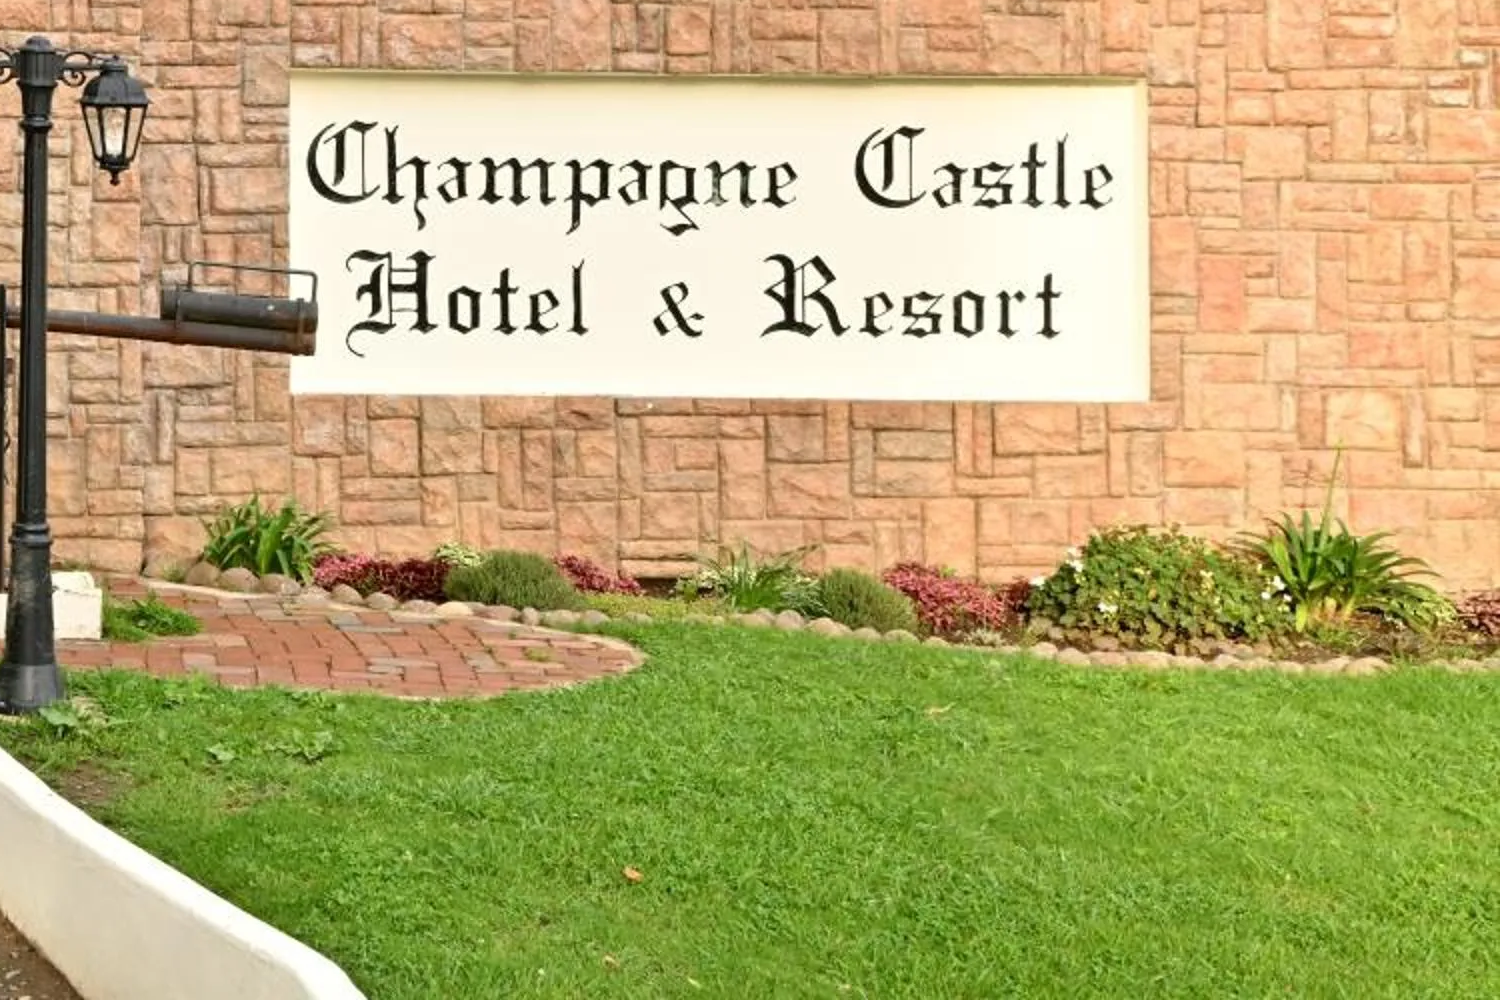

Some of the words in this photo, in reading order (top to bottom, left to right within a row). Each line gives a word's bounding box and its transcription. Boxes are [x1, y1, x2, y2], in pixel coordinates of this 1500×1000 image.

[306, 119, 798, 238] Champagne
[854, 125, 1114, 210] Castle
[345, 248, 587, 358] Hotel
[651, 281, 704, 339] &
[760, 253, 1062, 340] Resort
